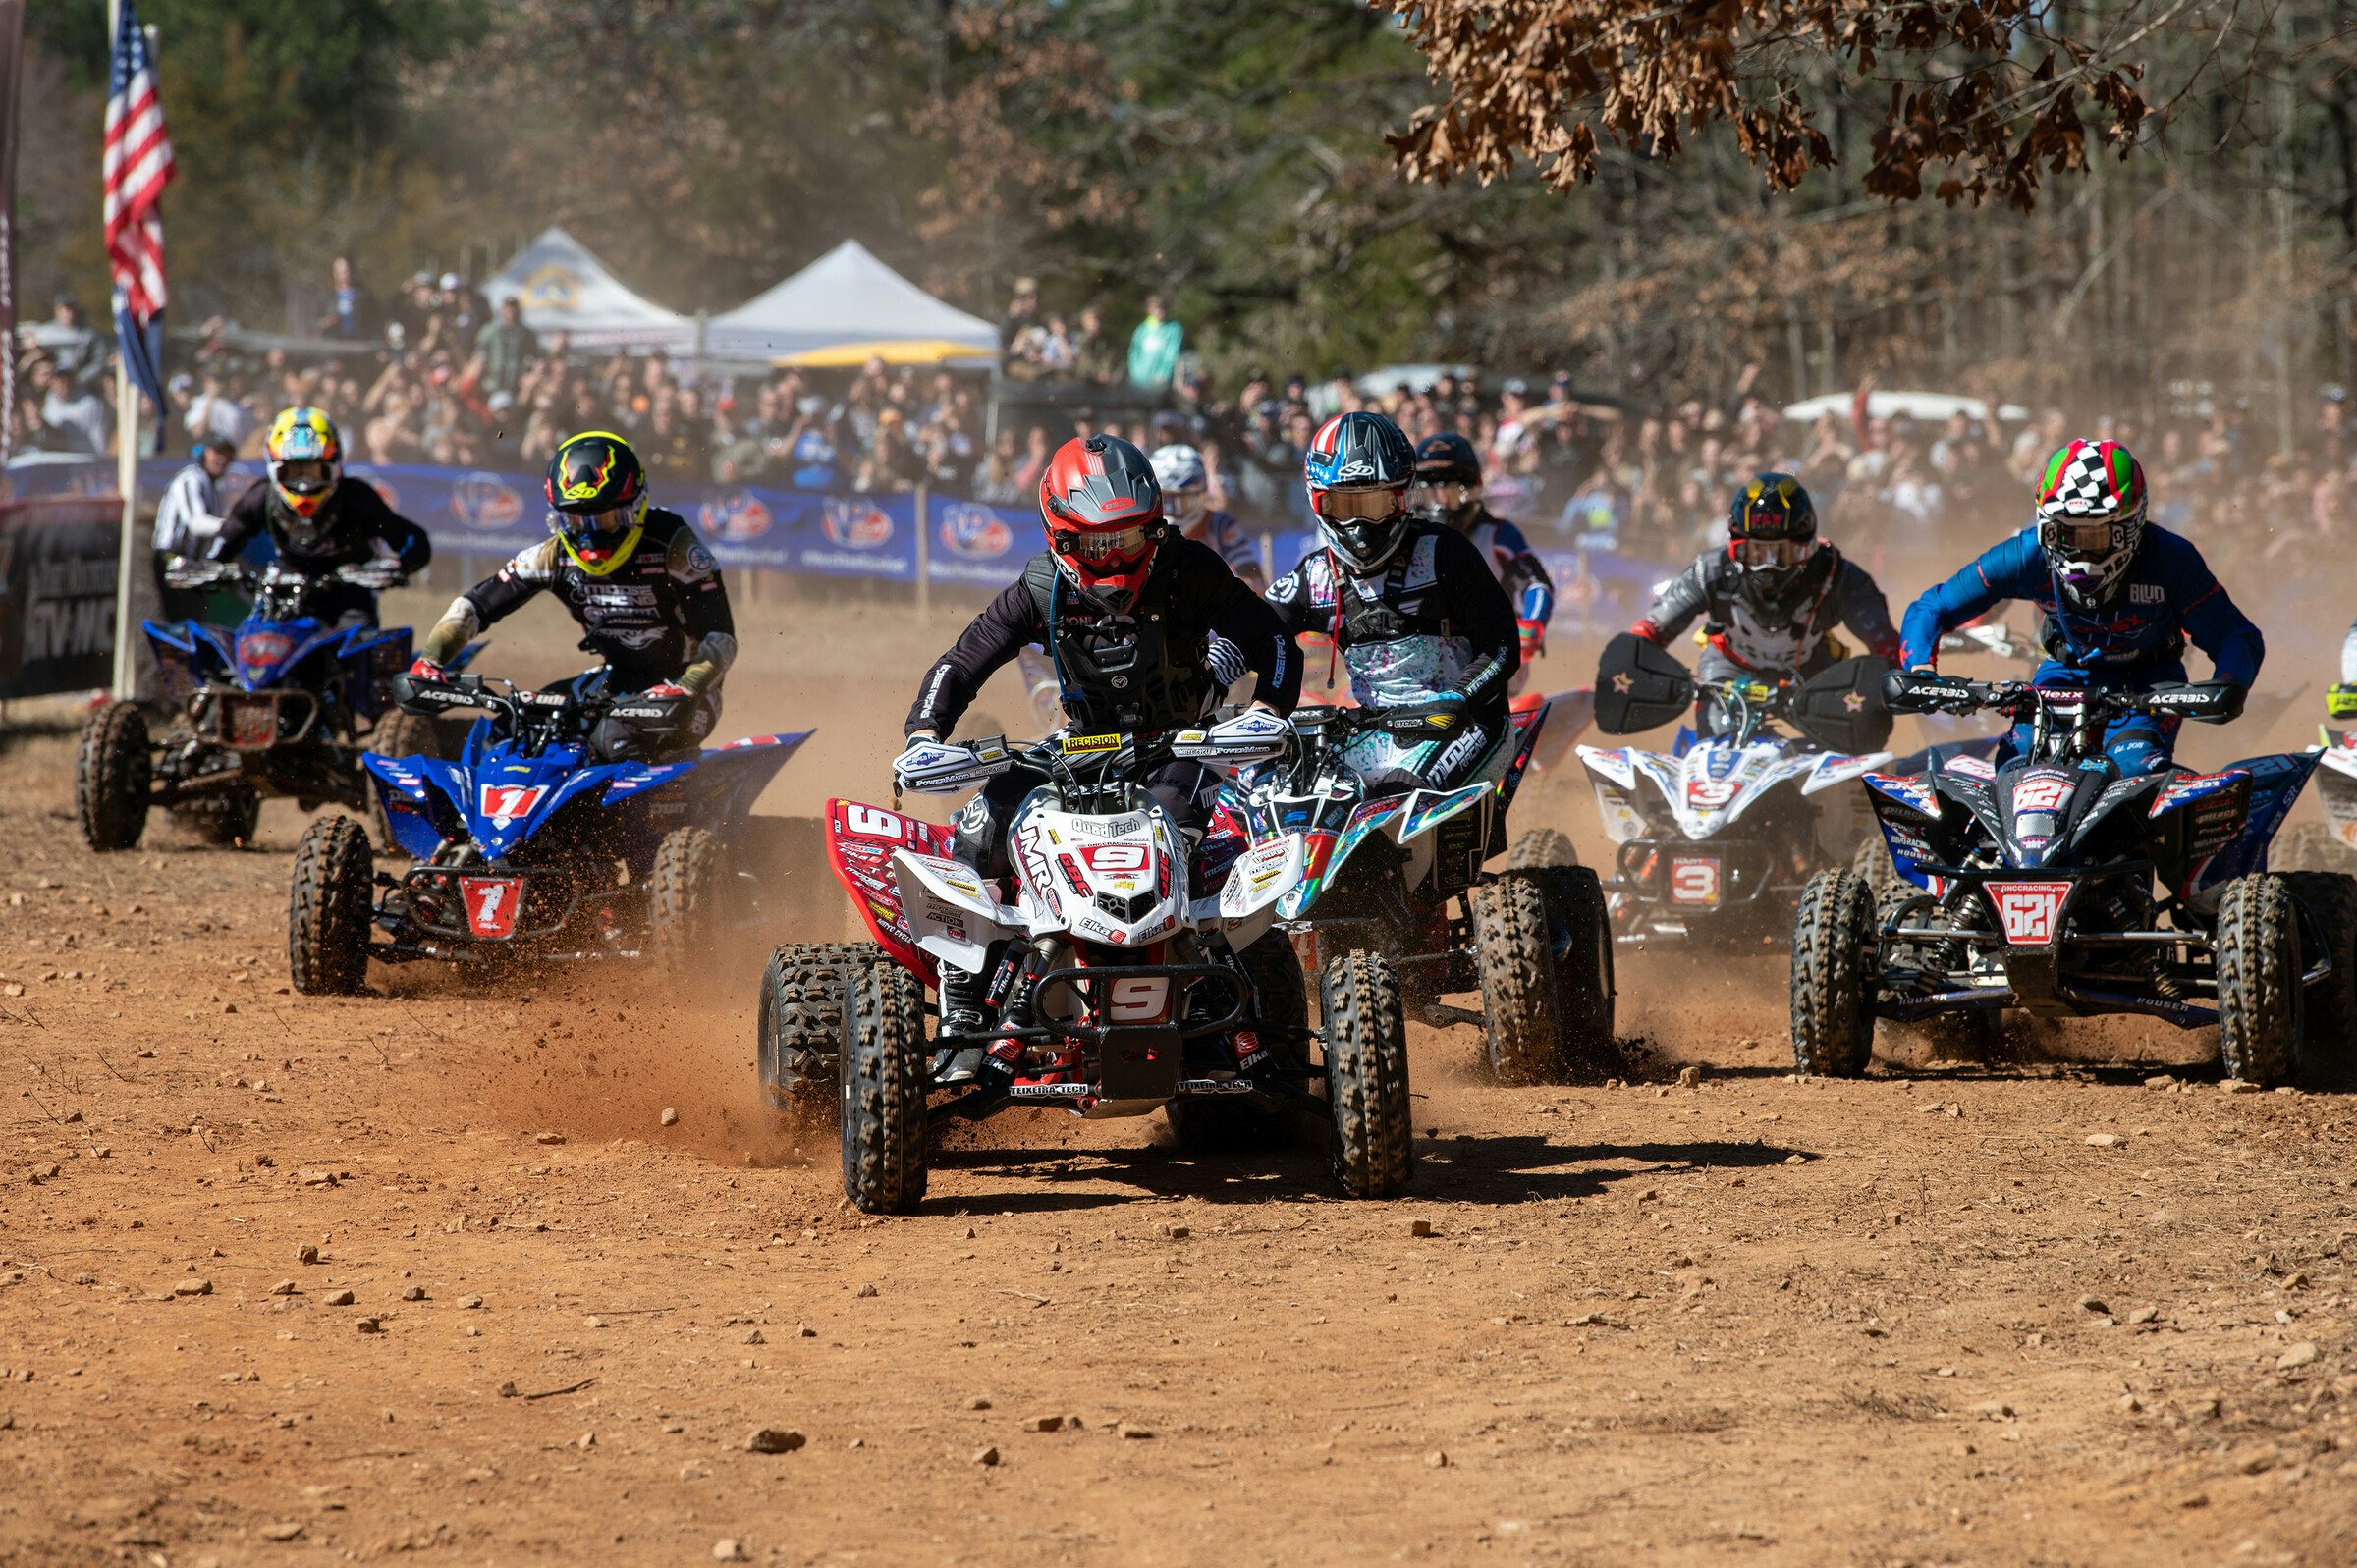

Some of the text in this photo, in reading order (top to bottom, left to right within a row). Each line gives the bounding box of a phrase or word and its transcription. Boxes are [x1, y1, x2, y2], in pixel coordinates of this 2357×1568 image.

[419, 689, 475, 706] ACERBIS
[1908, 685, 1970, 700] ACERBIS
[2148, 692, 2210, 705] ACERBIS
[609, 707, 664, 719] ACERBIS
[1458, 733, 1488, 772] RACING
[499, 788, 524, 814] 1
[1689, 783, 1736, 804] 3
[2013, 781, 2075, 814] 621
[847, 805, 903, 839] 9
[1016, 823, 1054, 898] JMR
[1089, 846, 1146, 870] 9
[1896, 848, 1935, 863] HOUSER
[1058, 852, 1094, 898] GBC
[1672, 864, 1717, 900] 3
[476, 884, 505, 922] 1
[928, 912, 961, 927] ACTION
[1079, 917, 1113, 936] Elka
[2001, 894, 2057, 937] 621
[1137, 922, 1165, 944] Elka
[998, 971, 1013, 995] Elka
[1109, 976, 1171, 1022] 9
[1898, 994, 1947, 1006] HOUSER
[2136, 996, 2189, 1012] HOUSER
[982, 1054, 1014, 1076] Elka
[1239, 1050, 1270, 1072] Elka
[1011, 1083, 1088, 1096] TEIXEIRA TECH
[1179, 1079, 1253, 1092] TEIXEIRA TECH
